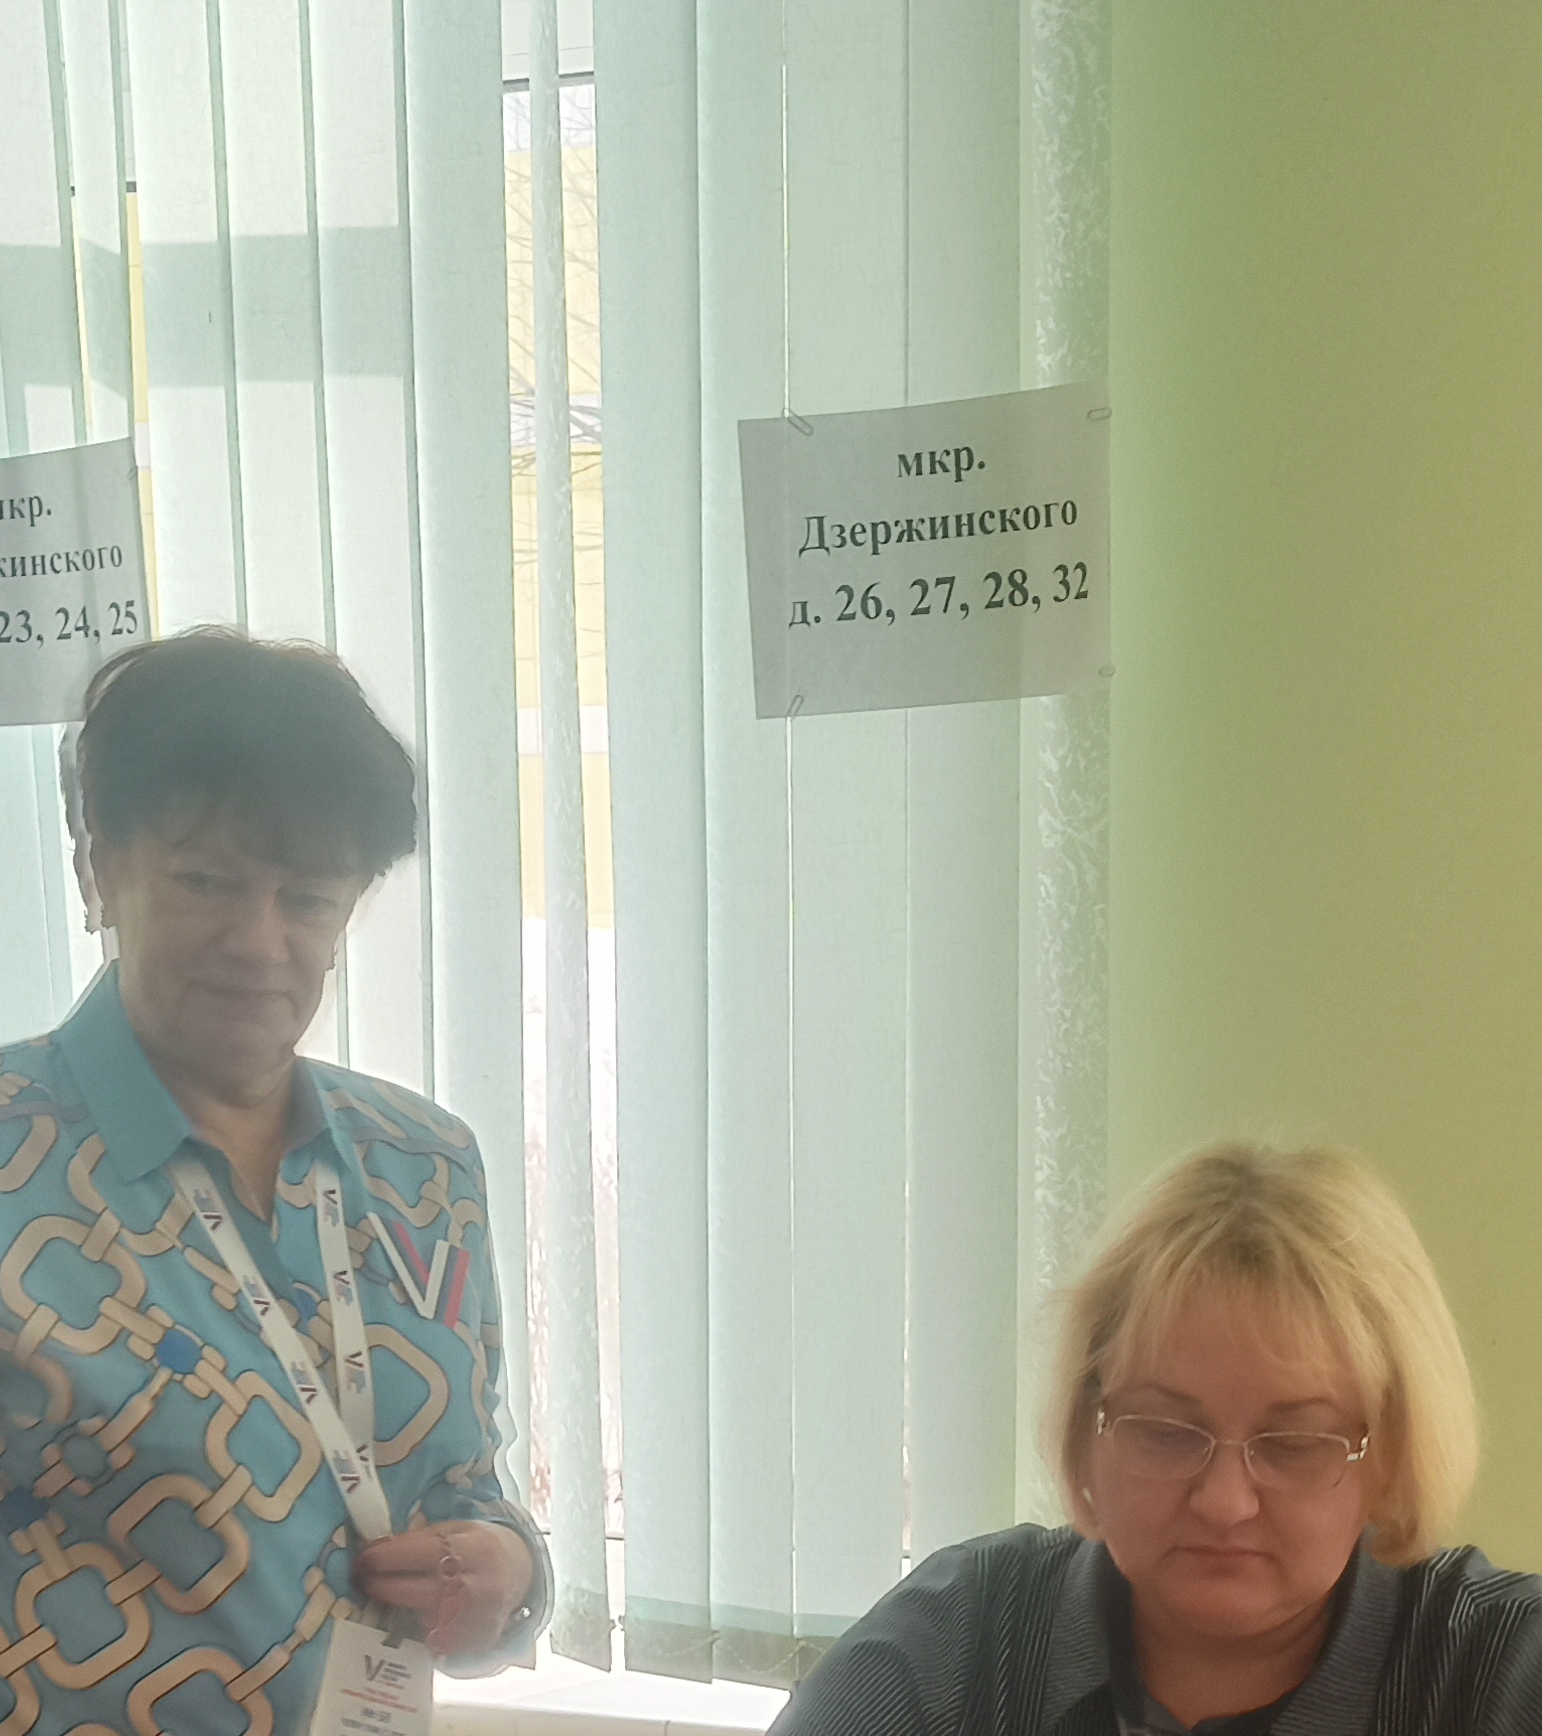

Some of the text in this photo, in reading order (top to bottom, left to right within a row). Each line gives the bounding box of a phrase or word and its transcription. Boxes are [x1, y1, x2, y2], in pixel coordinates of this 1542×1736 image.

[897, 446, 986, 482] мкр.
[798, 500, 1078, 558] Дзержинского
[788, 562, 1089, 629] д. 26, 27, 28, 32
[54, 605, 100, 645] 24,
[109, 600, 138, 635] 25
